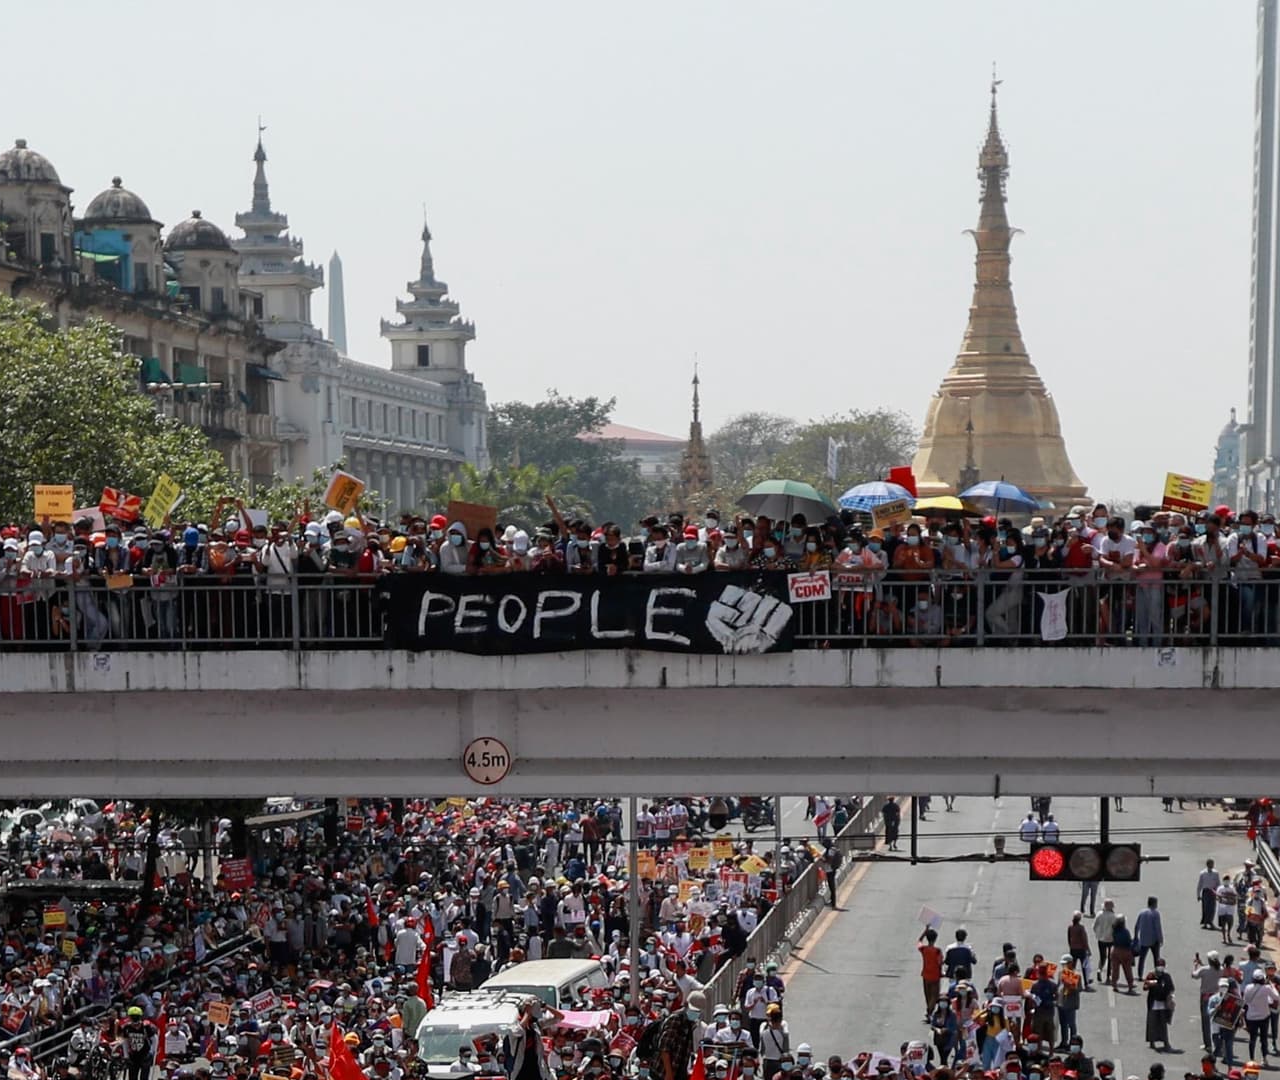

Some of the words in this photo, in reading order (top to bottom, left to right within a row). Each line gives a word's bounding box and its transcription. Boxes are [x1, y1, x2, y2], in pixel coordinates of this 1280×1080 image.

[795, 584, 825, 598] CDM
[419, 588, 697, 646] PEOPLE
[467, 752, 506, 767] 4.5m
